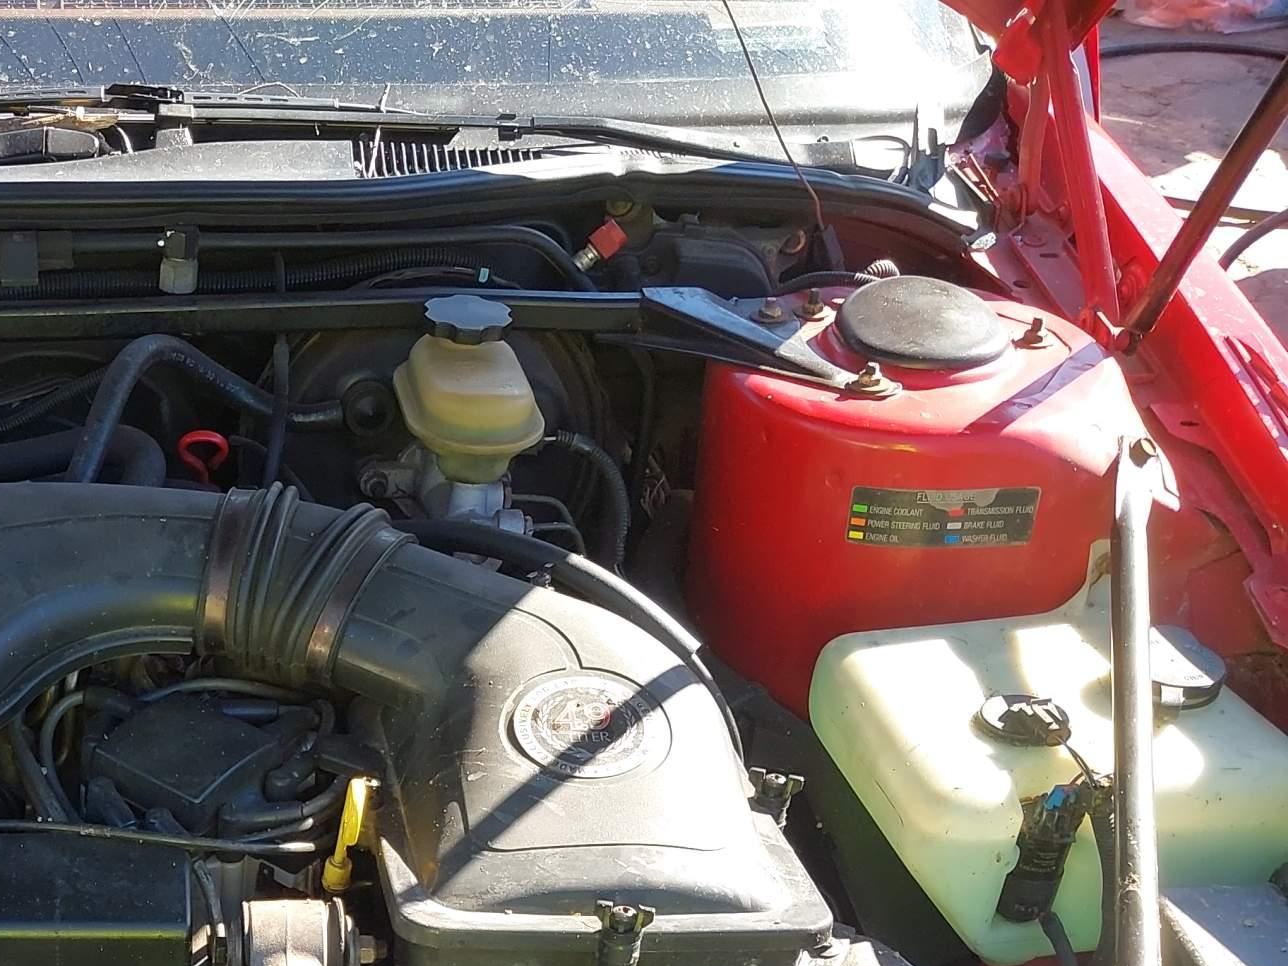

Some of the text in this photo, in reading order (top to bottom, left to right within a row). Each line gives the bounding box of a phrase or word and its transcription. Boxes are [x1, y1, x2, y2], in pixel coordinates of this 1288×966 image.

[917, 492, 943, 502] FLD
[869, 506, 923, 516] ENGINE COOLANT
[967, 505, 1034, 516] TRANSMISSION FLUID
[867, 519, 941, 530] POWER STEERING FLUID
[964, 520, 1005, 530] BRAKE FLUID
[866, 532, 899, 543] ENGINE OIL
[962, 534, 1008, 544] WASHER FLUID
[551, 702, 612, 735] 4.9
[568, 731, 611, 743] LITER
